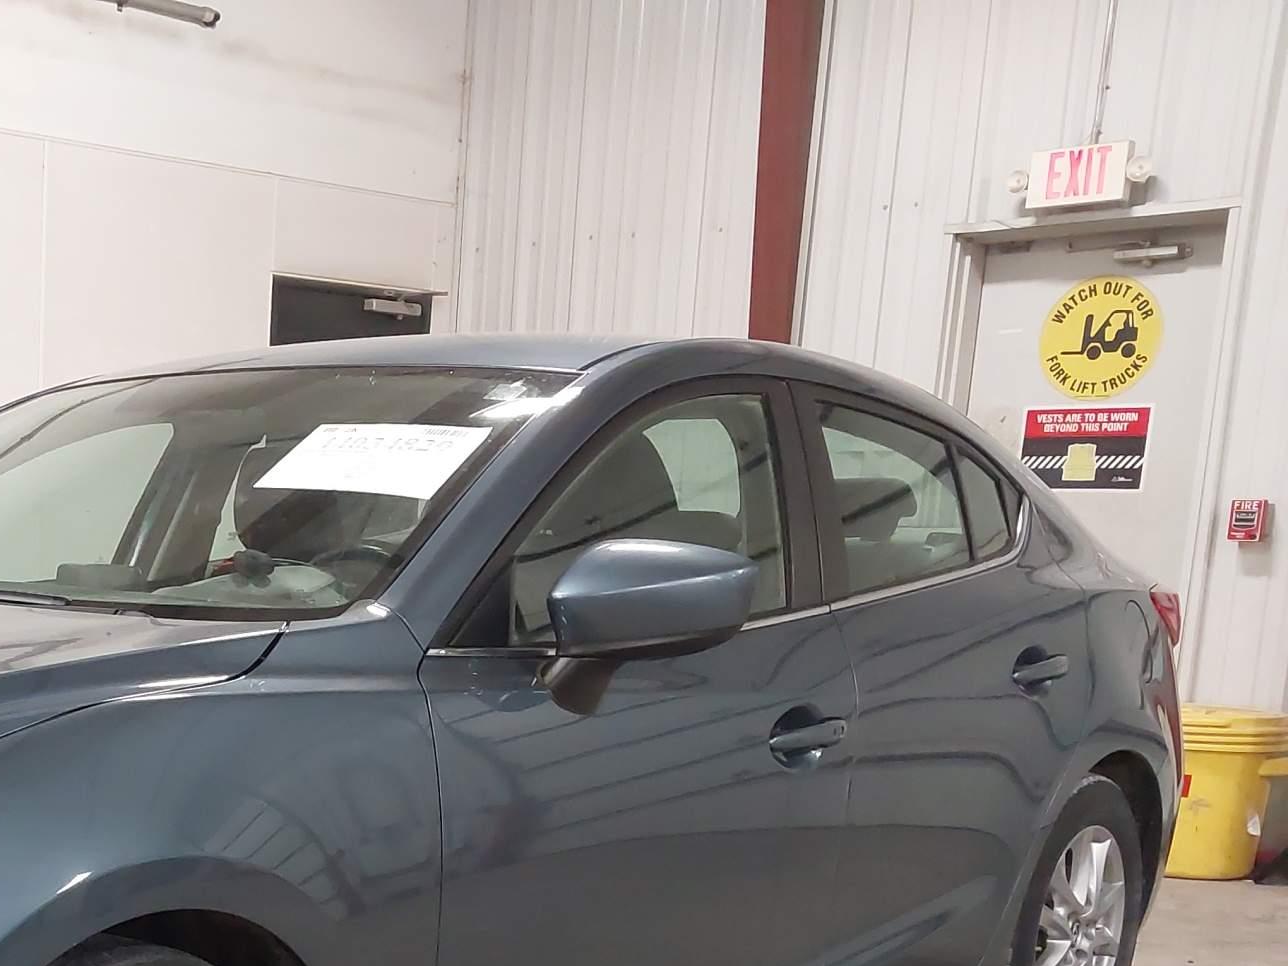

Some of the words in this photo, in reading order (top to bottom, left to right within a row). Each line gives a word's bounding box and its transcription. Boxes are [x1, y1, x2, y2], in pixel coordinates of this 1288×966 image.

[1045, 145, 1113, 200] EXIT
[1051, 283, 1098, 324] WATCH
[1103, 281, 1133, 298] OUT
[1130, 292, 1154, 321] FOR
[1046, 355, 1071, 386] FORK
[1070, 379, 1097, 394] LIFT
[1101, 353, 1148, 392] TRUCKS
[1036, 414, 1064, 423] VESTS
[1065, 413, 1083, 423] ARE
[1084, 413, 1096, 422] TO
[1097, 413, 1109, 422] BE
[1110, 412, 1139, 422] WORN
[1043, 423, 1079, 432] BEYOND
[1080, 423, 1100, 432] THIS
[1101, 422, 1130, 431] POINT
[1233, 500, 1260, 510] FIRE
